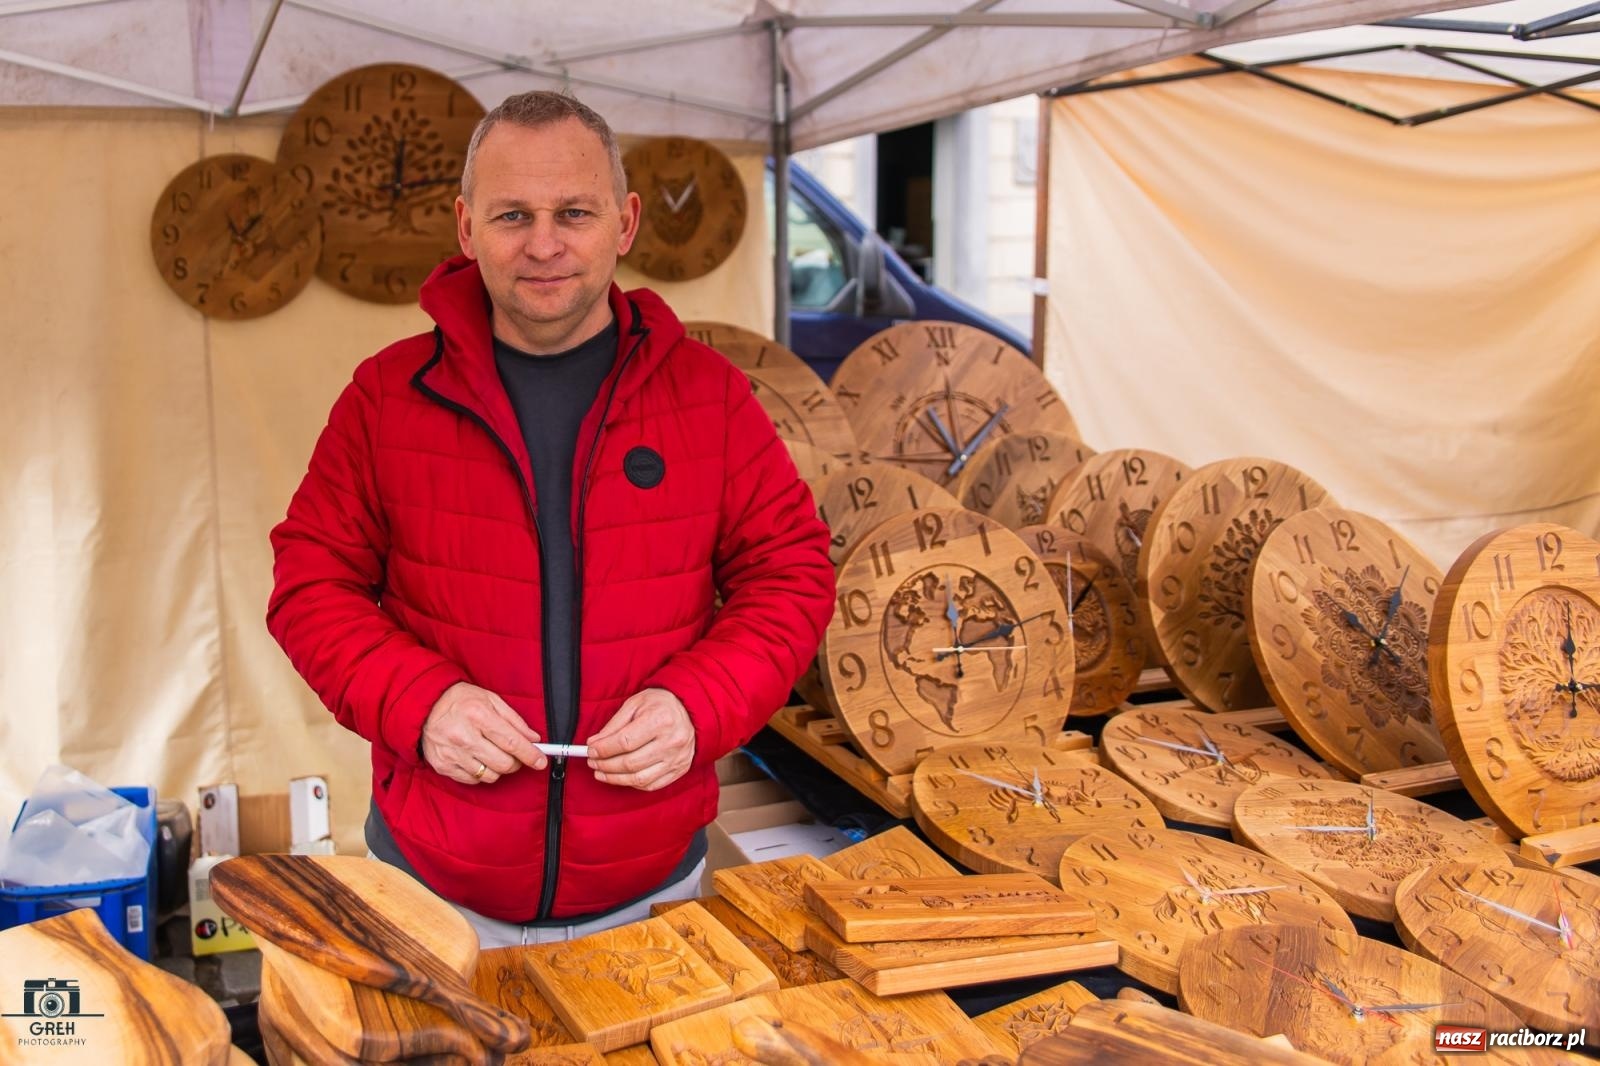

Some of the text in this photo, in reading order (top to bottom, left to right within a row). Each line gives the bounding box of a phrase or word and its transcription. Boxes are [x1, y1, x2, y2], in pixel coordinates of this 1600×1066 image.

[345, 84, 361, 112] 11
[390, 71, 416, 102] 12
[447, 92, 454, 117] 1
[304, 116, 333, 147] 10
[172, 192, 192, 213] 10
[163, 224, 180, 245] 9
[174, 257, 188, 279] 8
[338, 252, 356, 283] 7
[197, 283, 209, 304] 7
[230, 292, 247, 312] 6
[925, 326, 956, 349] XII
[872, 338, 899, 366] XI
[935, 351, 950, 367] N
[992, 346, 1005, 365] I
[802, 390, 825, 412] II
[837, 385, 861, 407] X
[1036, 389, 1058, 410] II
[1027, 436, 1051, 462] 12
[995, 452, 1011, 476] 11
[1122, 457, 1148, 486] 12
[847, 477, 878, 512] 12
[972, 483, 995, 509] 10
[1086, 474, 1106, 501] 11
[1242, 466, 1269, 499] 12
[907, 484, 918, 510] 1
[1201, 483, 1221, 515] 11
[1299, 484, 1308, 511] 1
[913, 513, 947, 553] 12
[1060, 508, 1086, 535] 10
[1329, 519, 1360, 552] 12
[977, 523, 992, 557] 1
[1036, 530, 1057, 554] 12
[1168, 521, 1196, 554] 10
[1293, 534, 1316, 565] 11
[869, 541, 895, 579] 11
[1388, 539, 1401, 569] 1
[1536, 532, 1566, 572] 12
[1014, 556, 1040, 592] 2
[1103, 566, 1118, 588] 2
[1493, 552, 1516, 591] 11
[1161, 575, 1184, 612] 9
[1268, 570, 1299, 603] 10
[838, 588, 873, 630] 10
[1462, 600, 1493, 643] 10
[1040, 610, 1064, 646] 3
[1272, 623, 1298, 660] 9
[1182, 630, 1202, 668] 8
[838, 652, 867, 693] 9
[1043, 667, 1065, 701] 4
[1302, 681, 1328, 719] 8
[1459, 668, 1484, 712] 9
[868, 709, 895, 748] 8
[1024, 714, 1046, 747] 5
[1223, 722, 1252, 738] 2
[948, 755, 970, 769] 11
[1042, 752, 1056, 766] 1
[1486, 737, 1510, 781] 8
[928, 773, 956, 790] 10
[1528, 787, 1548, 831] 7
[1091, 844, 1118, 861] 11
[1073, 867, 1108, 886] 10
[1483, 869, 1524, 887] 12
[1562, 881, 1581, 899] 1
[1415, 894, 1454, 913] 10
